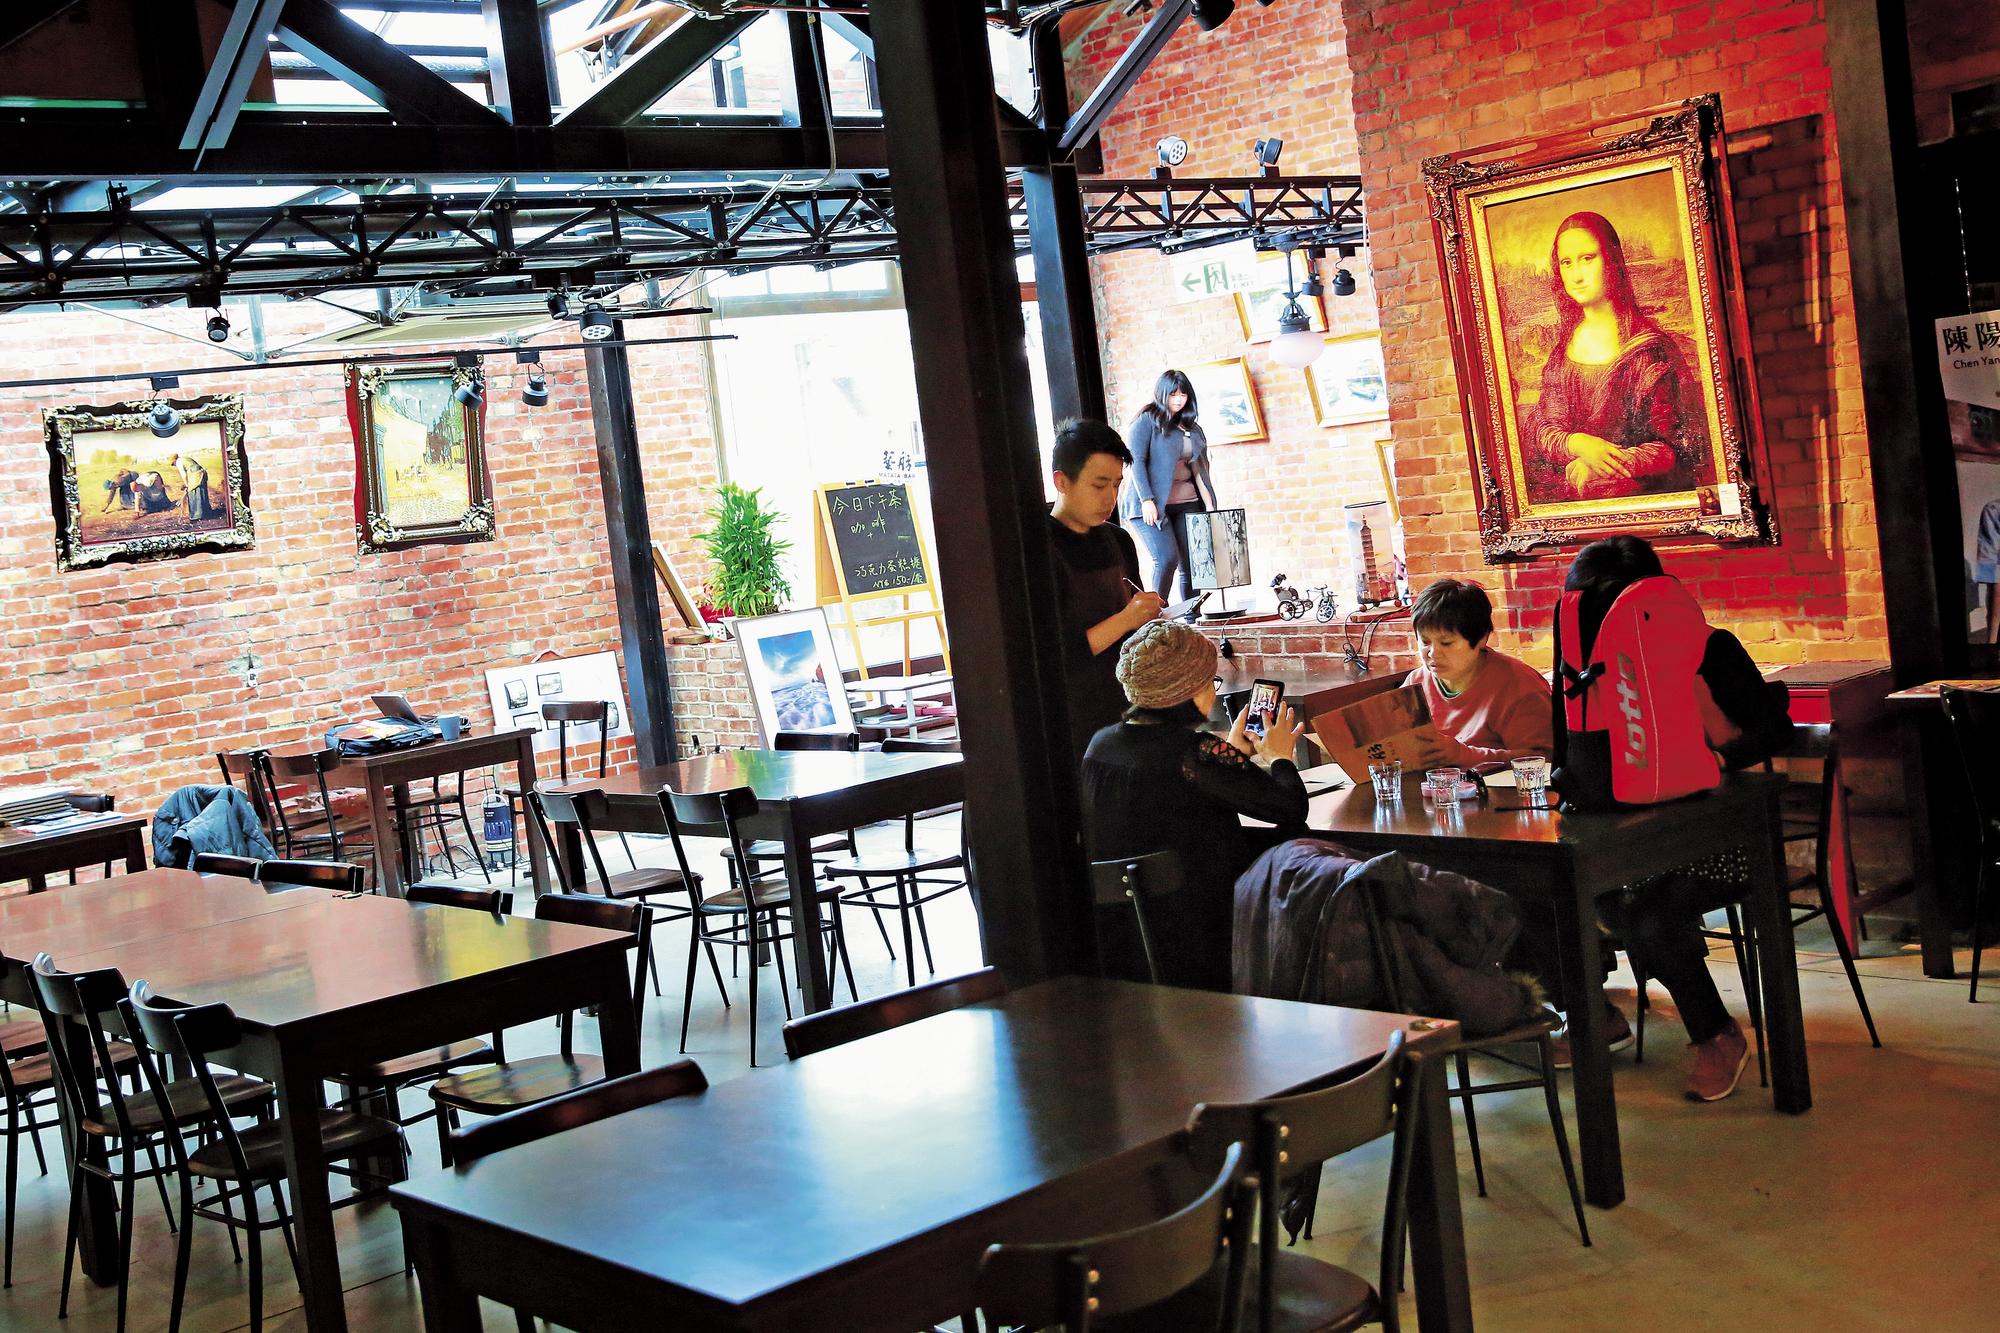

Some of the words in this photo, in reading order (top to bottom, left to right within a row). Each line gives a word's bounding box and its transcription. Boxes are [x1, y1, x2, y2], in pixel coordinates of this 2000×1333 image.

[1953, 359, 1979, 369] Chen
[832, 489, 902, 516] 今日下午茶
[850, 511, 886, 534] 咖啡
